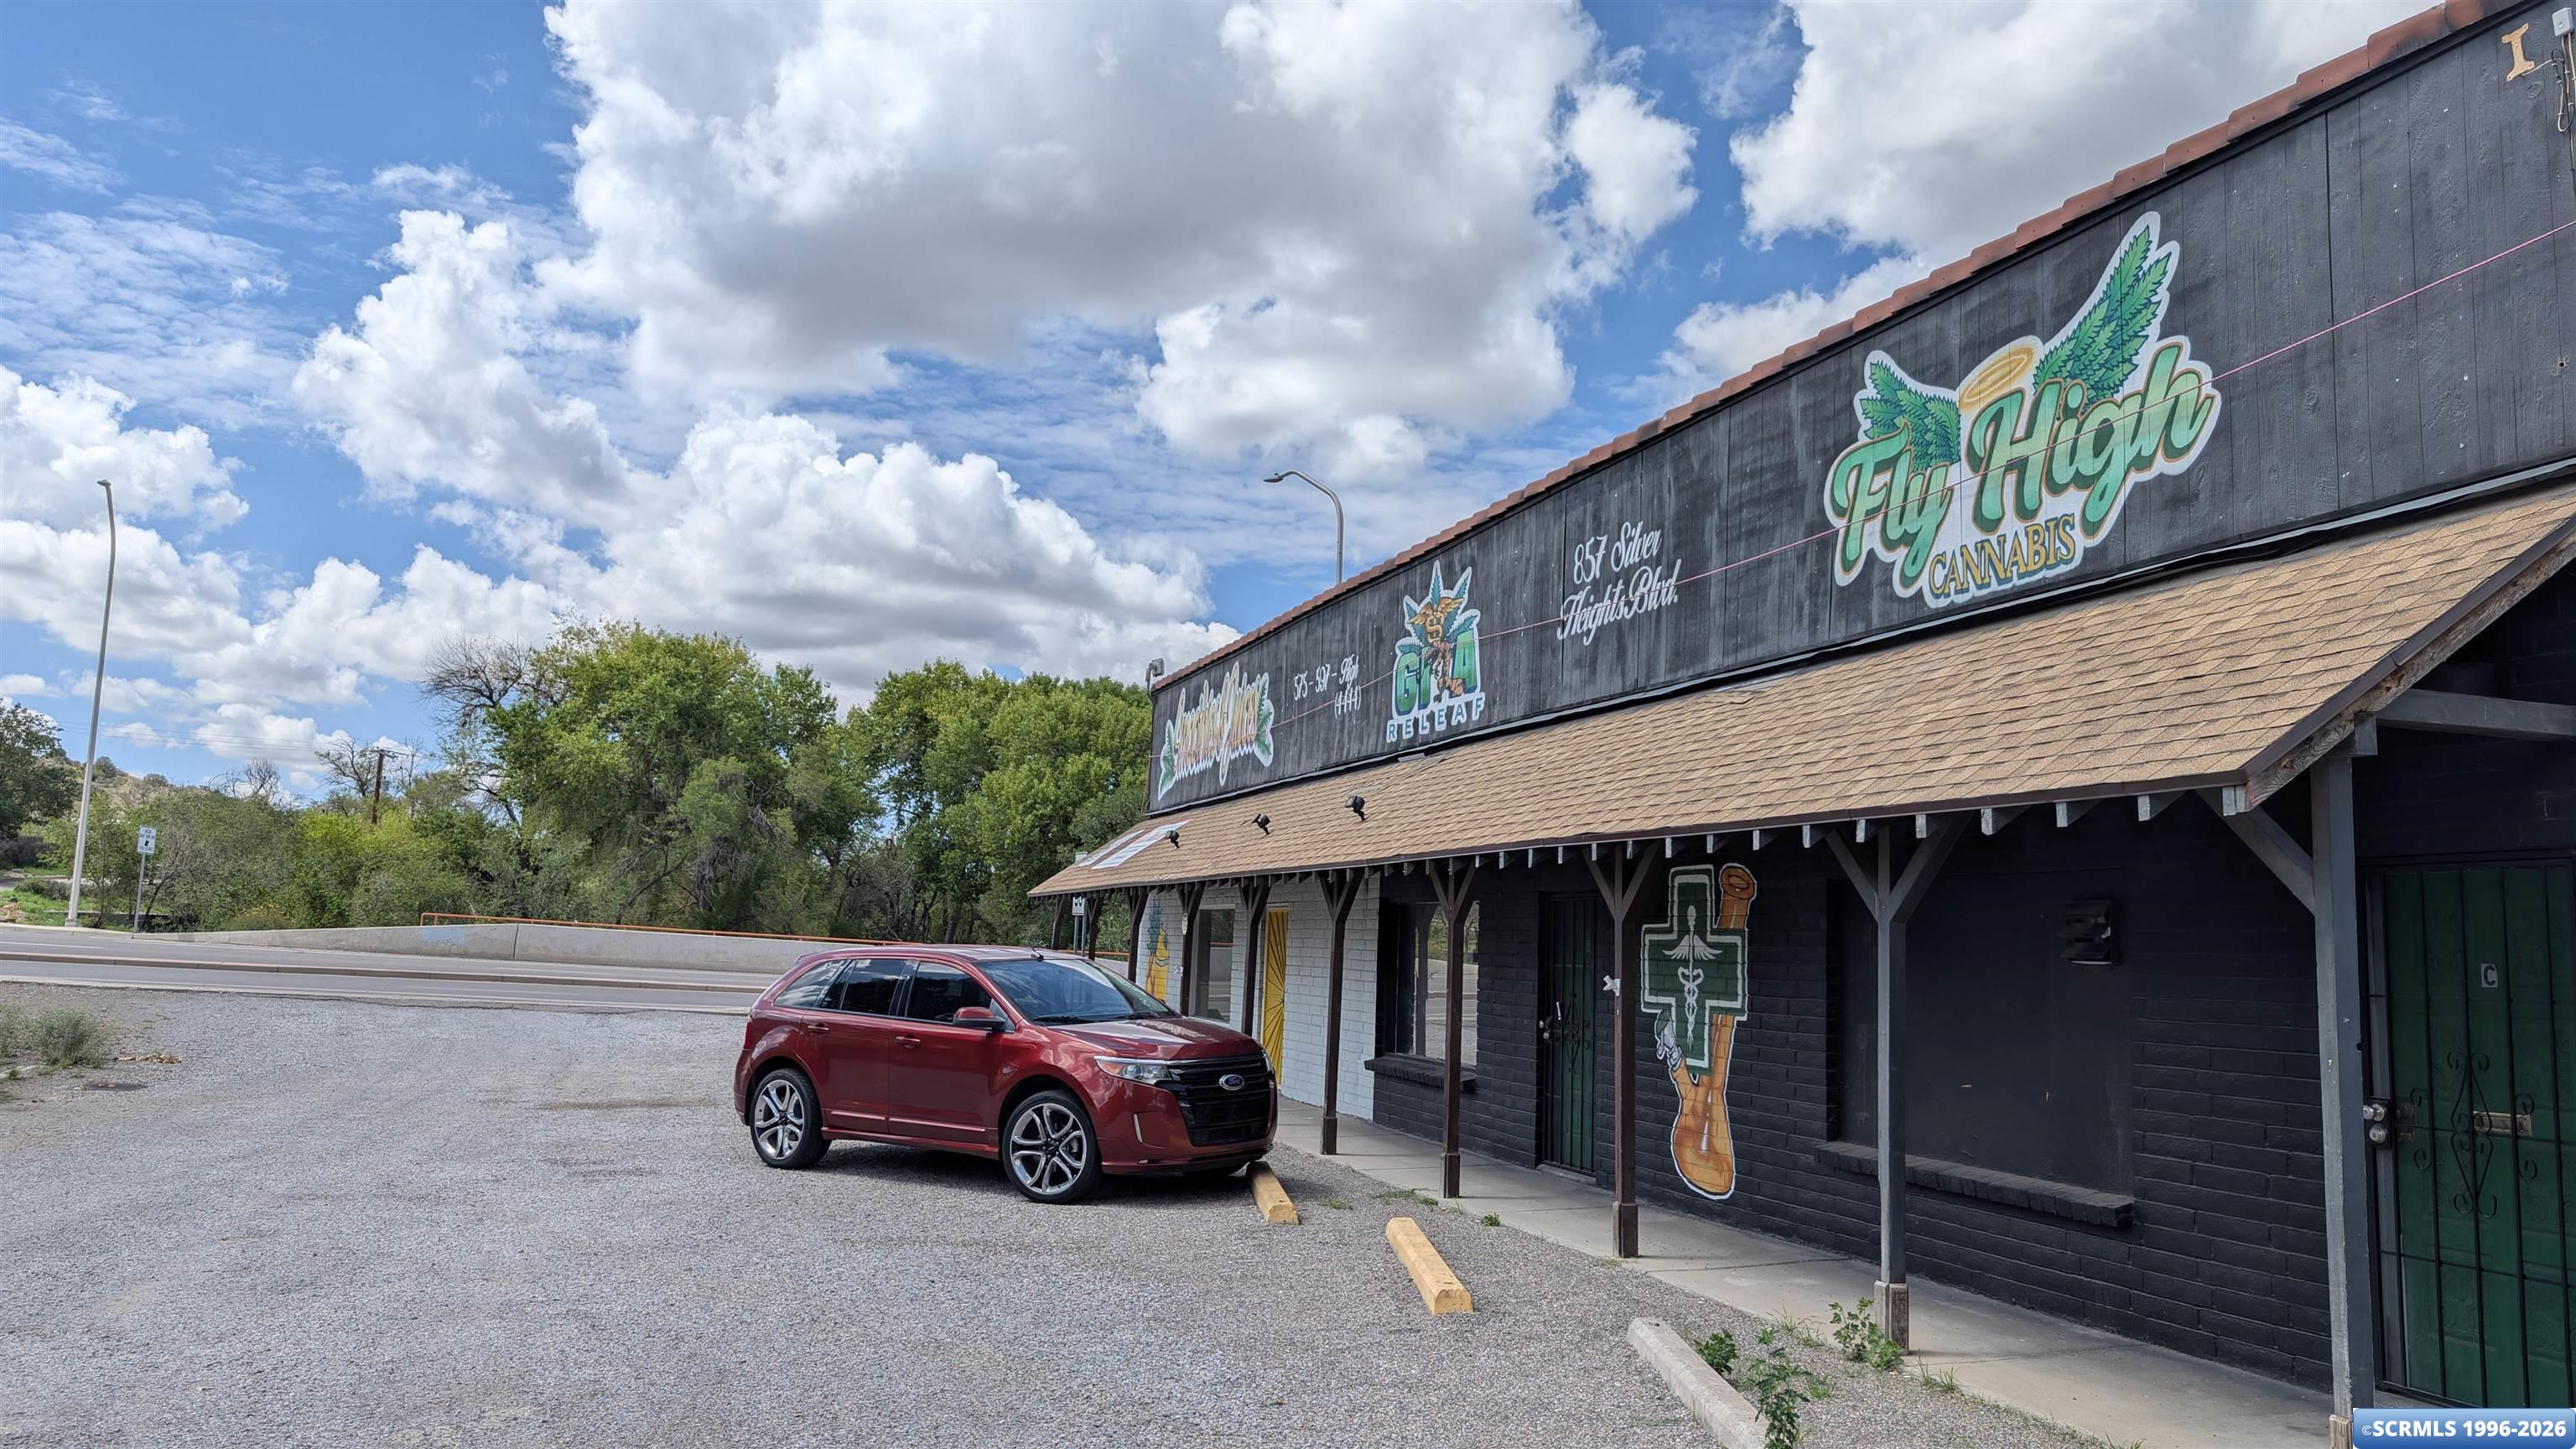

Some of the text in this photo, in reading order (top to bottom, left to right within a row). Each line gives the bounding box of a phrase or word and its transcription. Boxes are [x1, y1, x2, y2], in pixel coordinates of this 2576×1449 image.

[1830, 342, 2216, 589] Fly High
[1573, 521, 1662, 584] 857 Silver
[1929, 513, 2077, 599] CANNABIS
[1556, 579, 1626, 646] Heights
[1388, 695, 1484, 741] RELEAF
[2484, 964, 2496, 986] C
